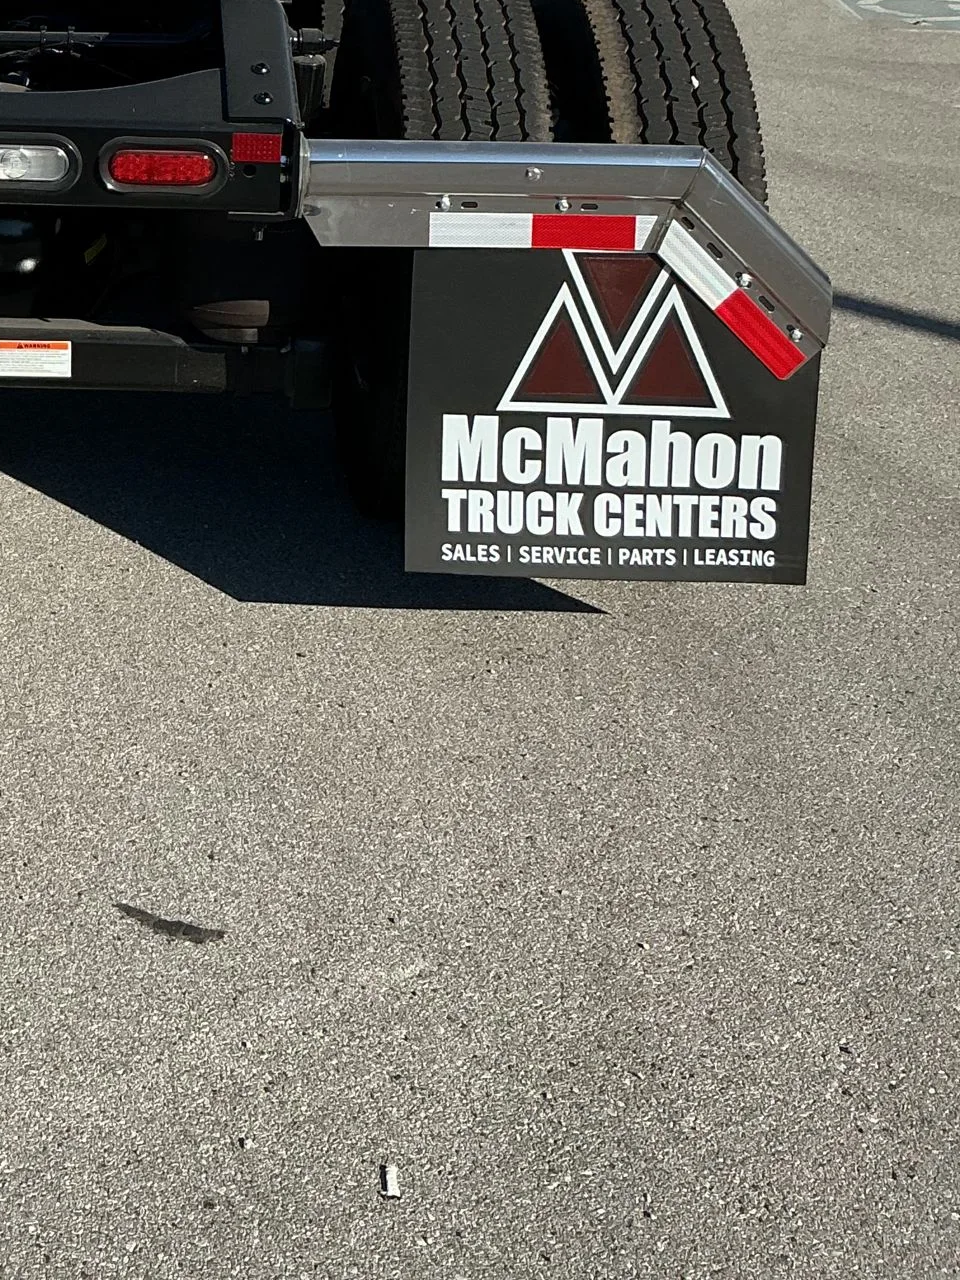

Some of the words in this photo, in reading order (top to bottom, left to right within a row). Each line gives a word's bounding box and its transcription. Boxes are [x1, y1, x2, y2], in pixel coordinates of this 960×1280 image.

[441, 413, 783, 491] McMahon
[441, 488, 585, 536] TRUCK
[593, 492, 777, 540] CENTERS
[441, 543, 501, 563] SALES
[518, 545, 601, 566] SERVICE
[618, 547, 677, 566] PARTS
[693, 548, 776, 567] LEASING
